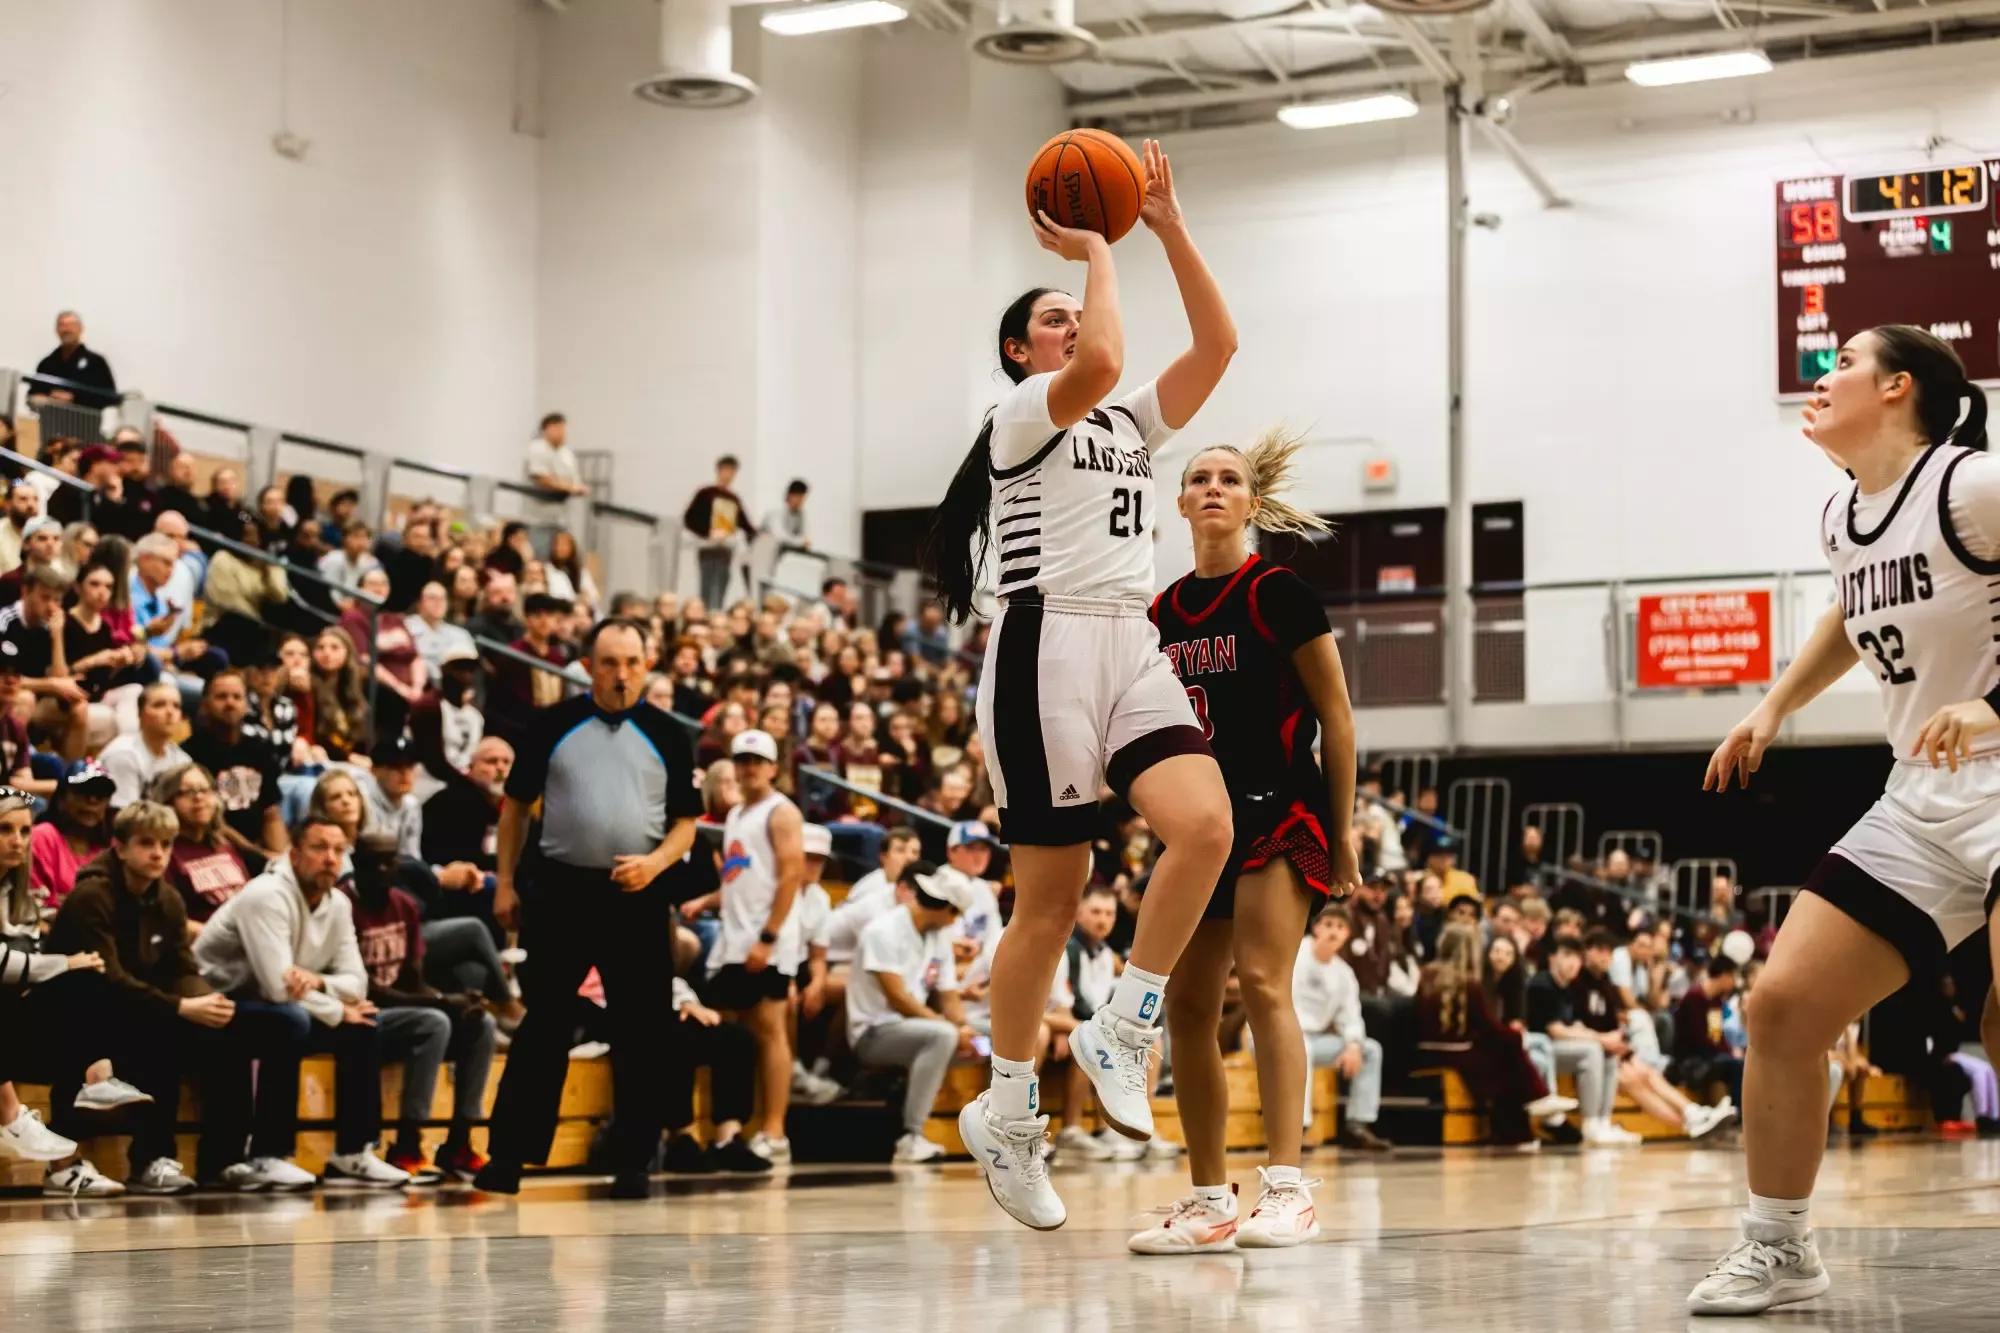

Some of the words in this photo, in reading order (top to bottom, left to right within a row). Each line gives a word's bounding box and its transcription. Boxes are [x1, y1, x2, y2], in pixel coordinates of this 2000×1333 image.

[1879, 167, 1976, 209] 4:12
[1791, 202, 1837, 244] 58
[1931, 221, 1952, 251] 4
[1804, 284, 1824, 314] 3
[1109, 487, 1143, 537] 21
[1869, 552, 1934, 612] LIONS
[1857, 624, 1917, 685] 32
[1060, 793, 1081, 801] adidas
